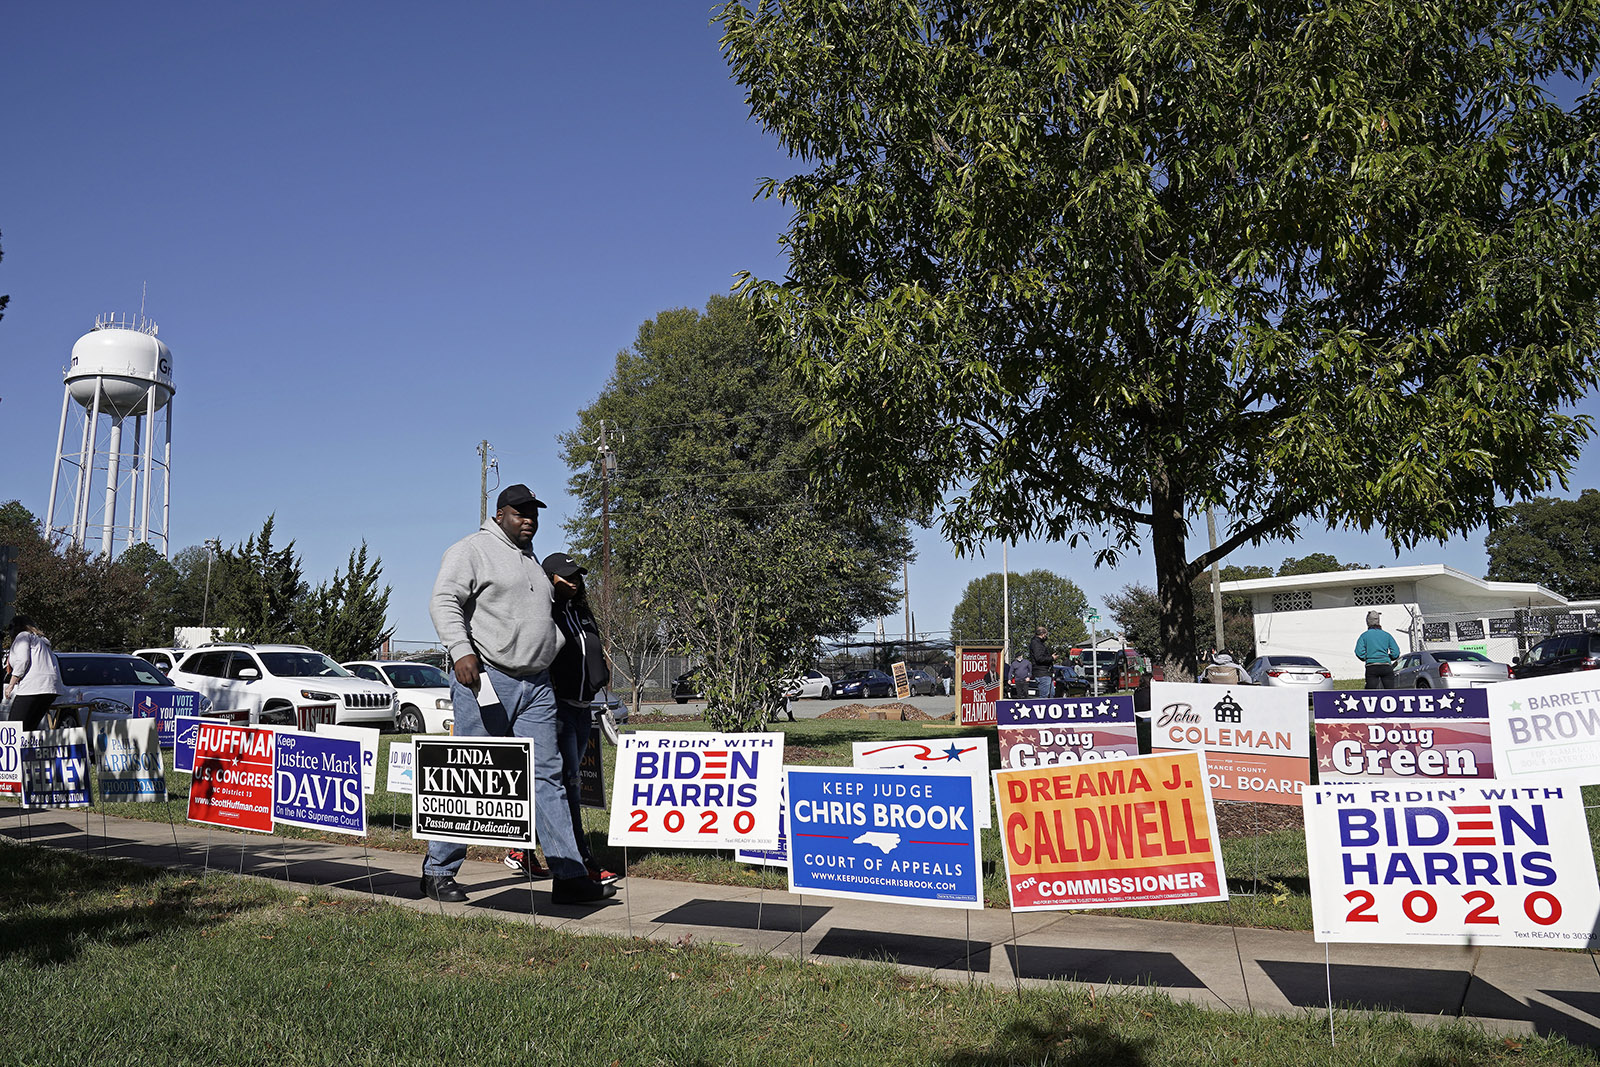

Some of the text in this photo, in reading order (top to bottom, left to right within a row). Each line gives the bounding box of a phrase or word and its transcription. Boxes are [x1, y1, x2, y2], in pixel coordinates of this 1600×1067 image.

[962, 660, 988, 675] JUDGE
[176, 695, 194, 706] VOTE
[973, 689, 987, 702] Rick
[1361, 695, 1435, 713] VOTE
[1527, 689, 1600, 710] BARRETT
[160, 708, 174, 719] YOU
[961, 701, 997, 723] CHAMPIO
[1032, 702, 1094, 719] VOTE
[1156, 702, 1202, 728] John
[1367, 725, 1434, 748] Doug
[1507, 708, 1600, 745] BROW
[277, 735, 296, 749] Keep
[625, 739, 650, 749] I'M
[724, 739, 774, 748] WITH
[1038, 730, 1093, 749] Doug
[1168, 725, 1292, 751] COLEMAN
[36, 747, 68, 759] BRIAN
[276, 747, 319, 770] Justice
[321, 752, 359, 775] Mark
[447, 748, 494, 765] LINDA
[1331, 739, 1479, 776] Green
[22, 758, 87, 792] FEELEY
[634, 751, 760, 780] BIDEN
[1236, 766, 1267, 774] COUNTY
[134, 780, 165, 792] BOARD
[194, 765, 273, 788] U.S. CONGRESS
[423, 766, 522, 797] KINNEY
[1007, 764, 1193, 804] DREAMA J.
[1237, 776, 1307, 795] BOARD
[53, 792, 84, 803] EDUCATION
[221, 788, 244, 797] District
[276, 770, 360, 815] DAVIS
[631, 783, 758, 807] HARRIS
[822, 782, 933, 798] KEEP JUDGE
[1315, 790, 1356, 805] I'M
[1480, 787, 1564, 800] WITH
[194, 796, 269, 814] www.ScottHuffman.com
[422, 797, 524, 818] SCHOOL BOARD
[794, 799, 969, 831] CHRIS BROOK
[275, 805, 360, 827] On the NC Supreme Court
[425, 816, 520, 835] Passion and Dedication
[628, 809, 756, 834] 2020
[1337, 804, 1549, 847] BIDEN
[1006, 798, 1211, 867] CALDWELL
[804, 854, 963, 876] COURT OF APPEALS
[1341, 851, 1558, 886] HARRIS
[811, 871, 956, 891] WWW.KEEPJUDGECHRISBROOK.COM
[1015, 871, 1207, 897] FOR COMMISSIONER
[1343, 889, 1563, 926] 2020
[1514, 930, 1597, 940] Text READY to 30330
